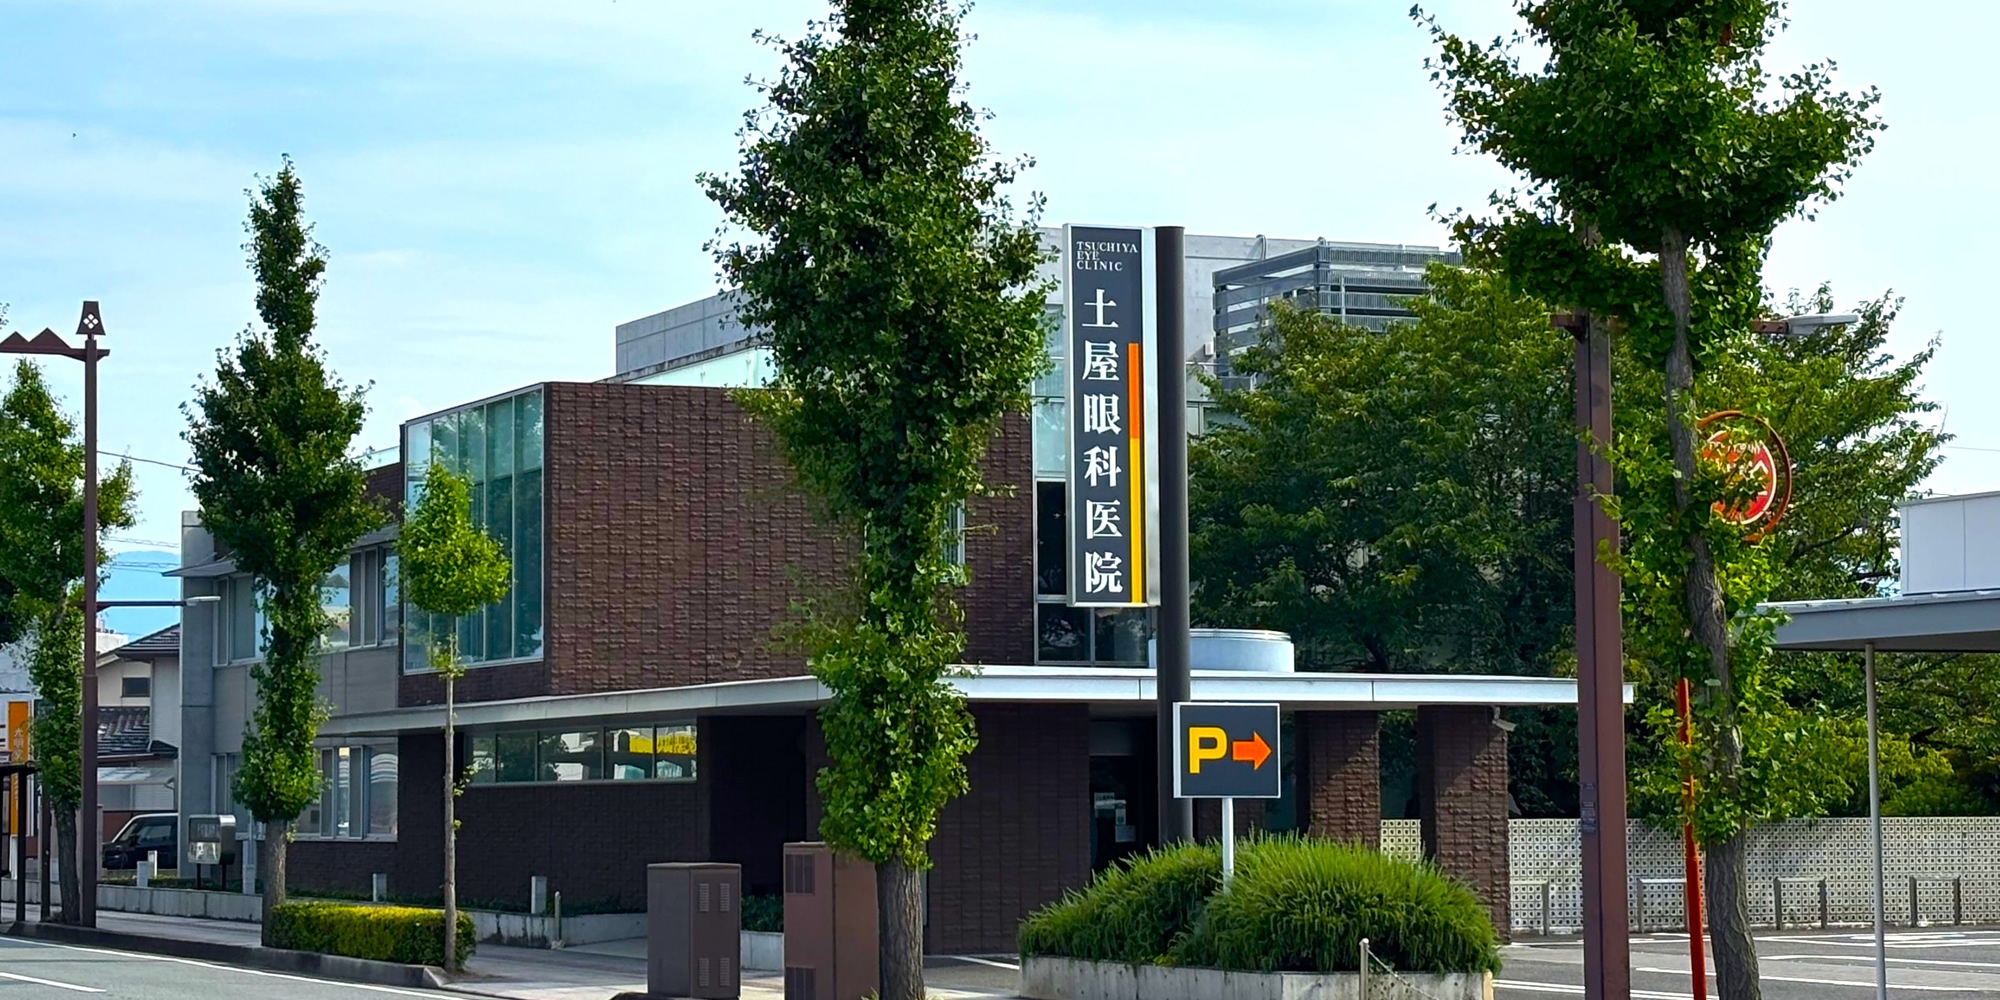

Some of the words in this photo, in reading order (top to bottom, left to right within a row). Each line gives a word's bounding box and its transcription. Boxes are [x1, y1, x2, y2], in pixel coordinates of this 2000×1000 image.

[1076, 241, 1138, 253] TSUCHIYA
[1076, 250, 1100, 260] EYE
[1076, 260, 1123, 271] CLINIC
[1082, 288, 1123, 594] 土屋眼科医院
[1189, 727, 1227, 774] P
